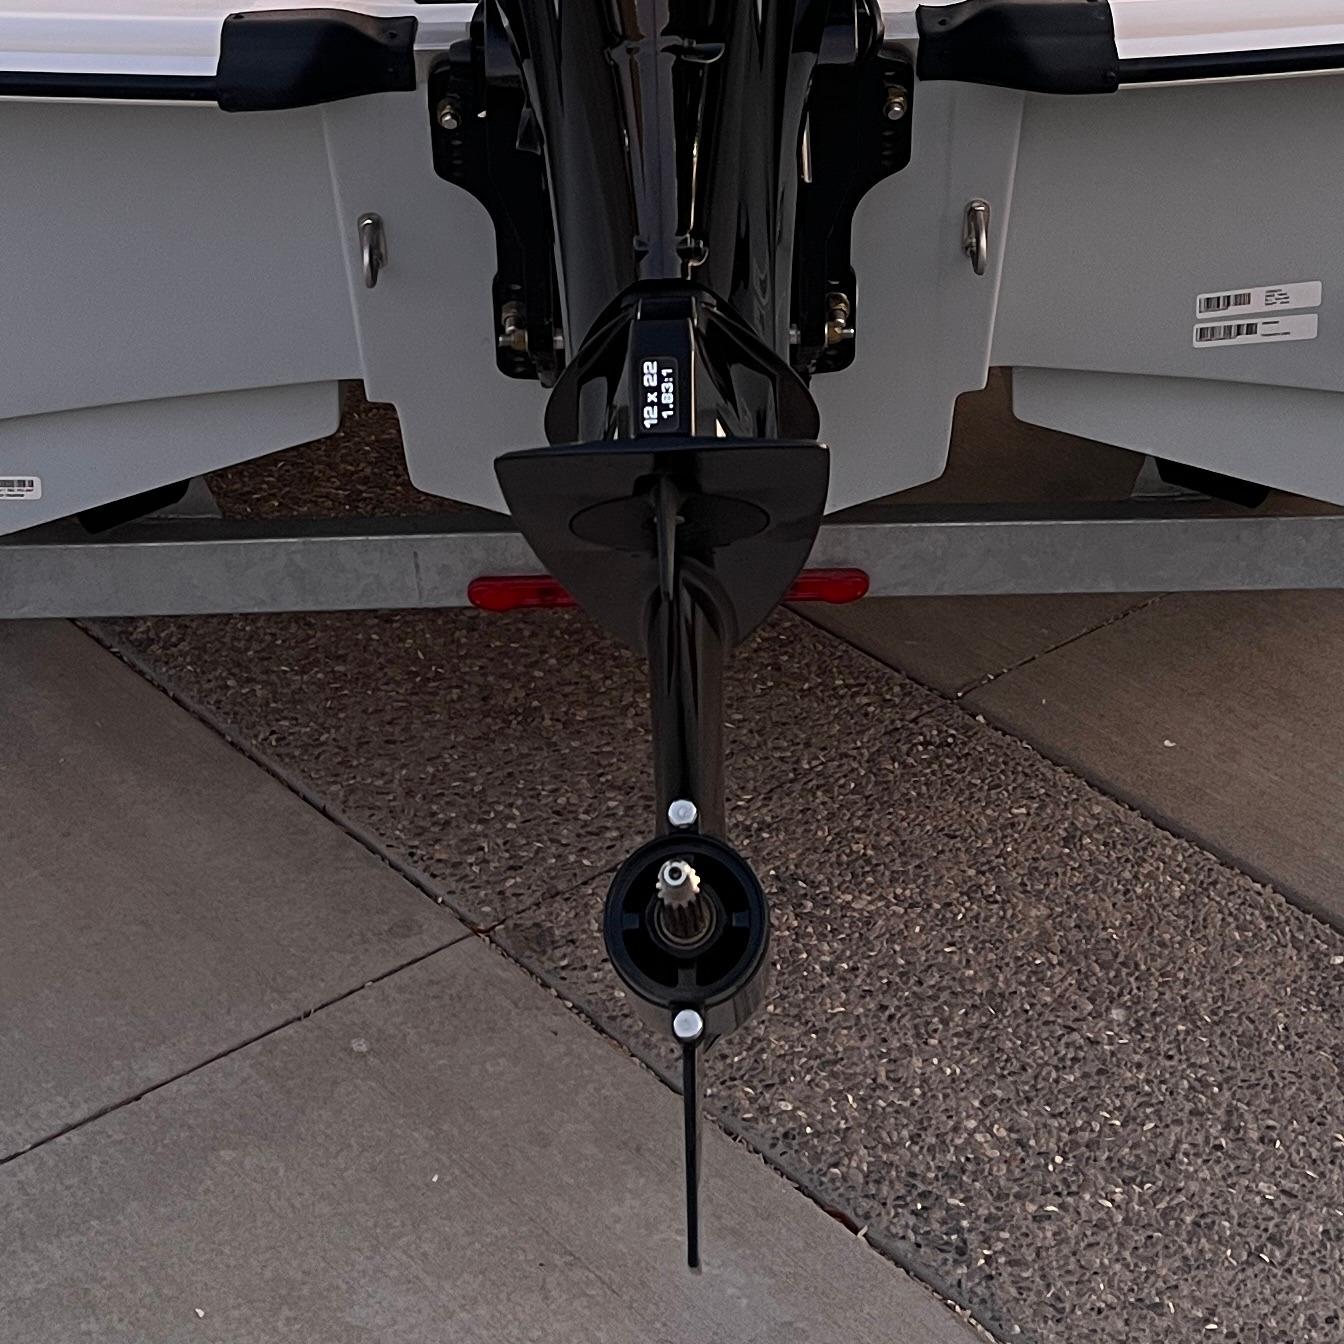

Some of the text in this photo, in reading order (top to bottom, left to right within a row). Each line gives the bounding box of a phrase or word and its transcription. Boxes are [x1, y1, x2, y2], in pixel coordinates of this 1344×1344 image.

[643, 360, 658, 429] 12 x 22
[661, 368, 674, 419] 1.83:1
